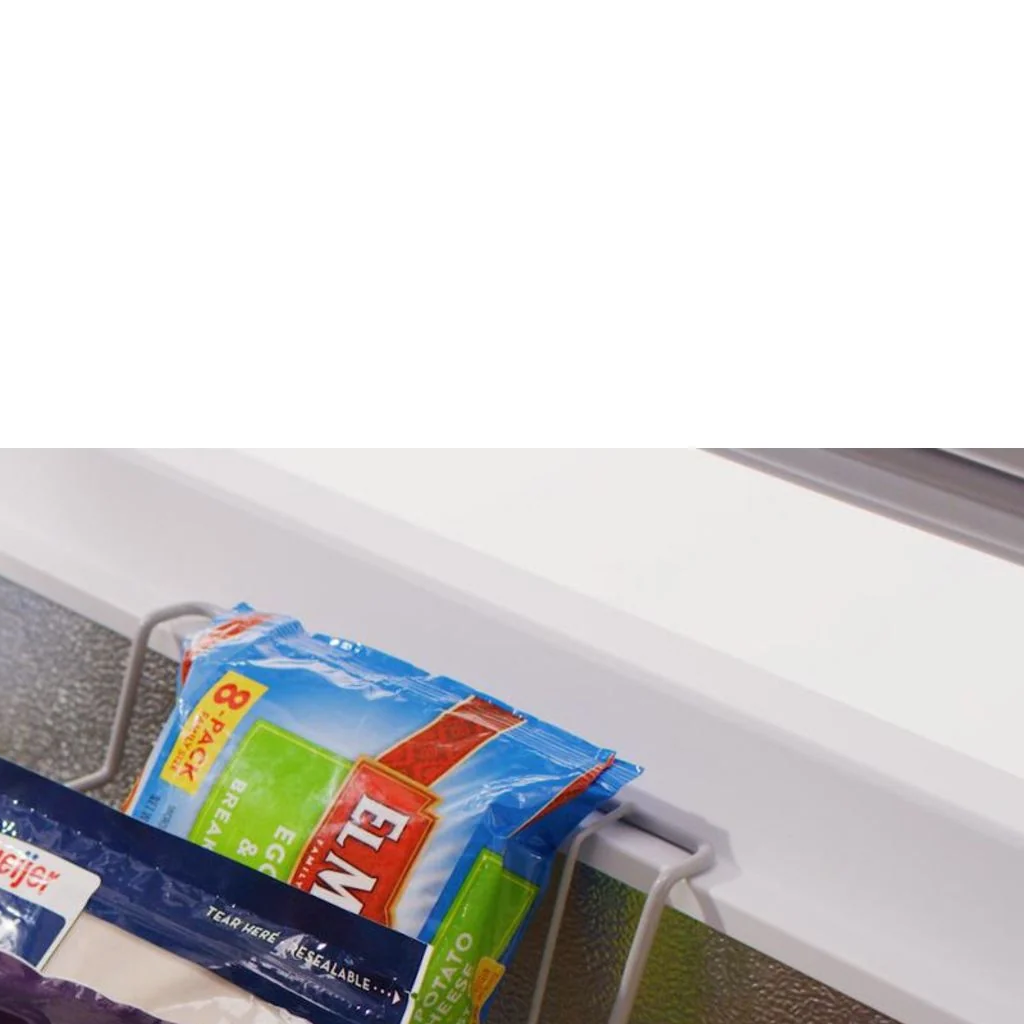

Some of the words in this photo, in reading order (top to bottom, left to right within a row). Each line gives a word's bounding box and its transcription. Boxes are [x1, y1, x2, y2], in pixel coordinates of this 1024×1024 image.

[178, 682, 252, 783] 8-PACK
[237, 837, 259, 857] &
[336, 793, 412, 851] EL
[206, 904, 242, 931] TEAR
[241, 920, 281, 945] HERE
[286, 942, 372, 992] RESEALABLE
[413, 930, 474, 1024] POTATO
